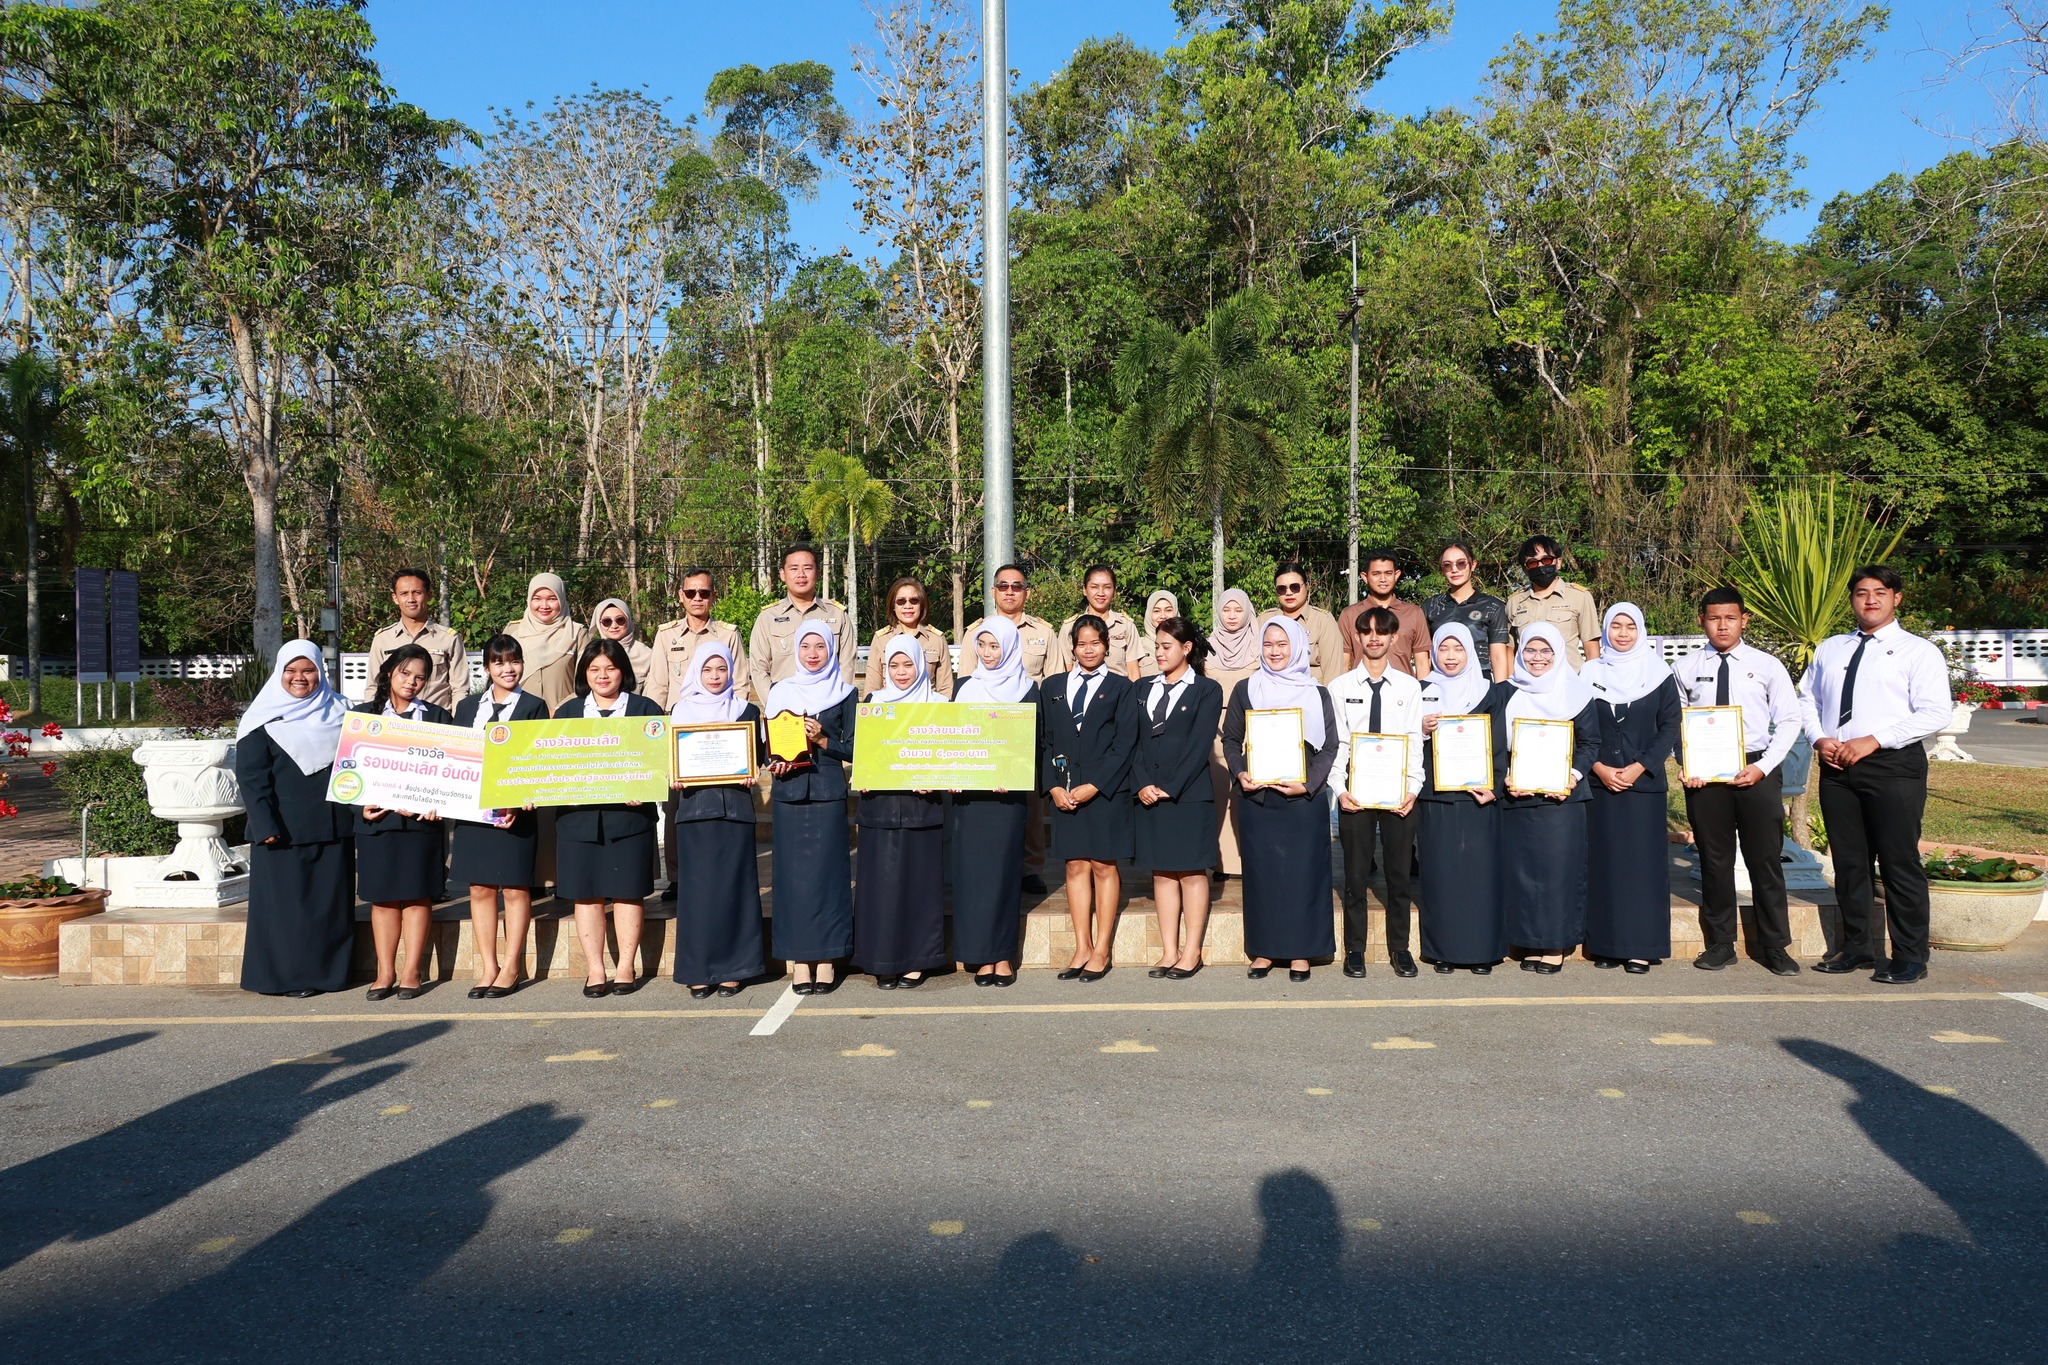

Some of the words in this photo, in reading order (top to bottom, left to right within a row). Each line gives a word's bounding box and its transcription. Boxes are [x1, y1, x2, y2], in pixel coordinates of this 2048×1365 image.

[908, 724, 981, 736] รางวัลชนะเลิศ
[534, 734, 620, 748] รางวัลชนะเลิศ
[407, 746, 445, 760] รางวัล
[900, 747, 932, 758] จำนวน
[968, 749, 988, 758] บาท
[363, 755, 438, 776] รองชนะเลิศ
[442, 763, 480, 782] อันดับ
